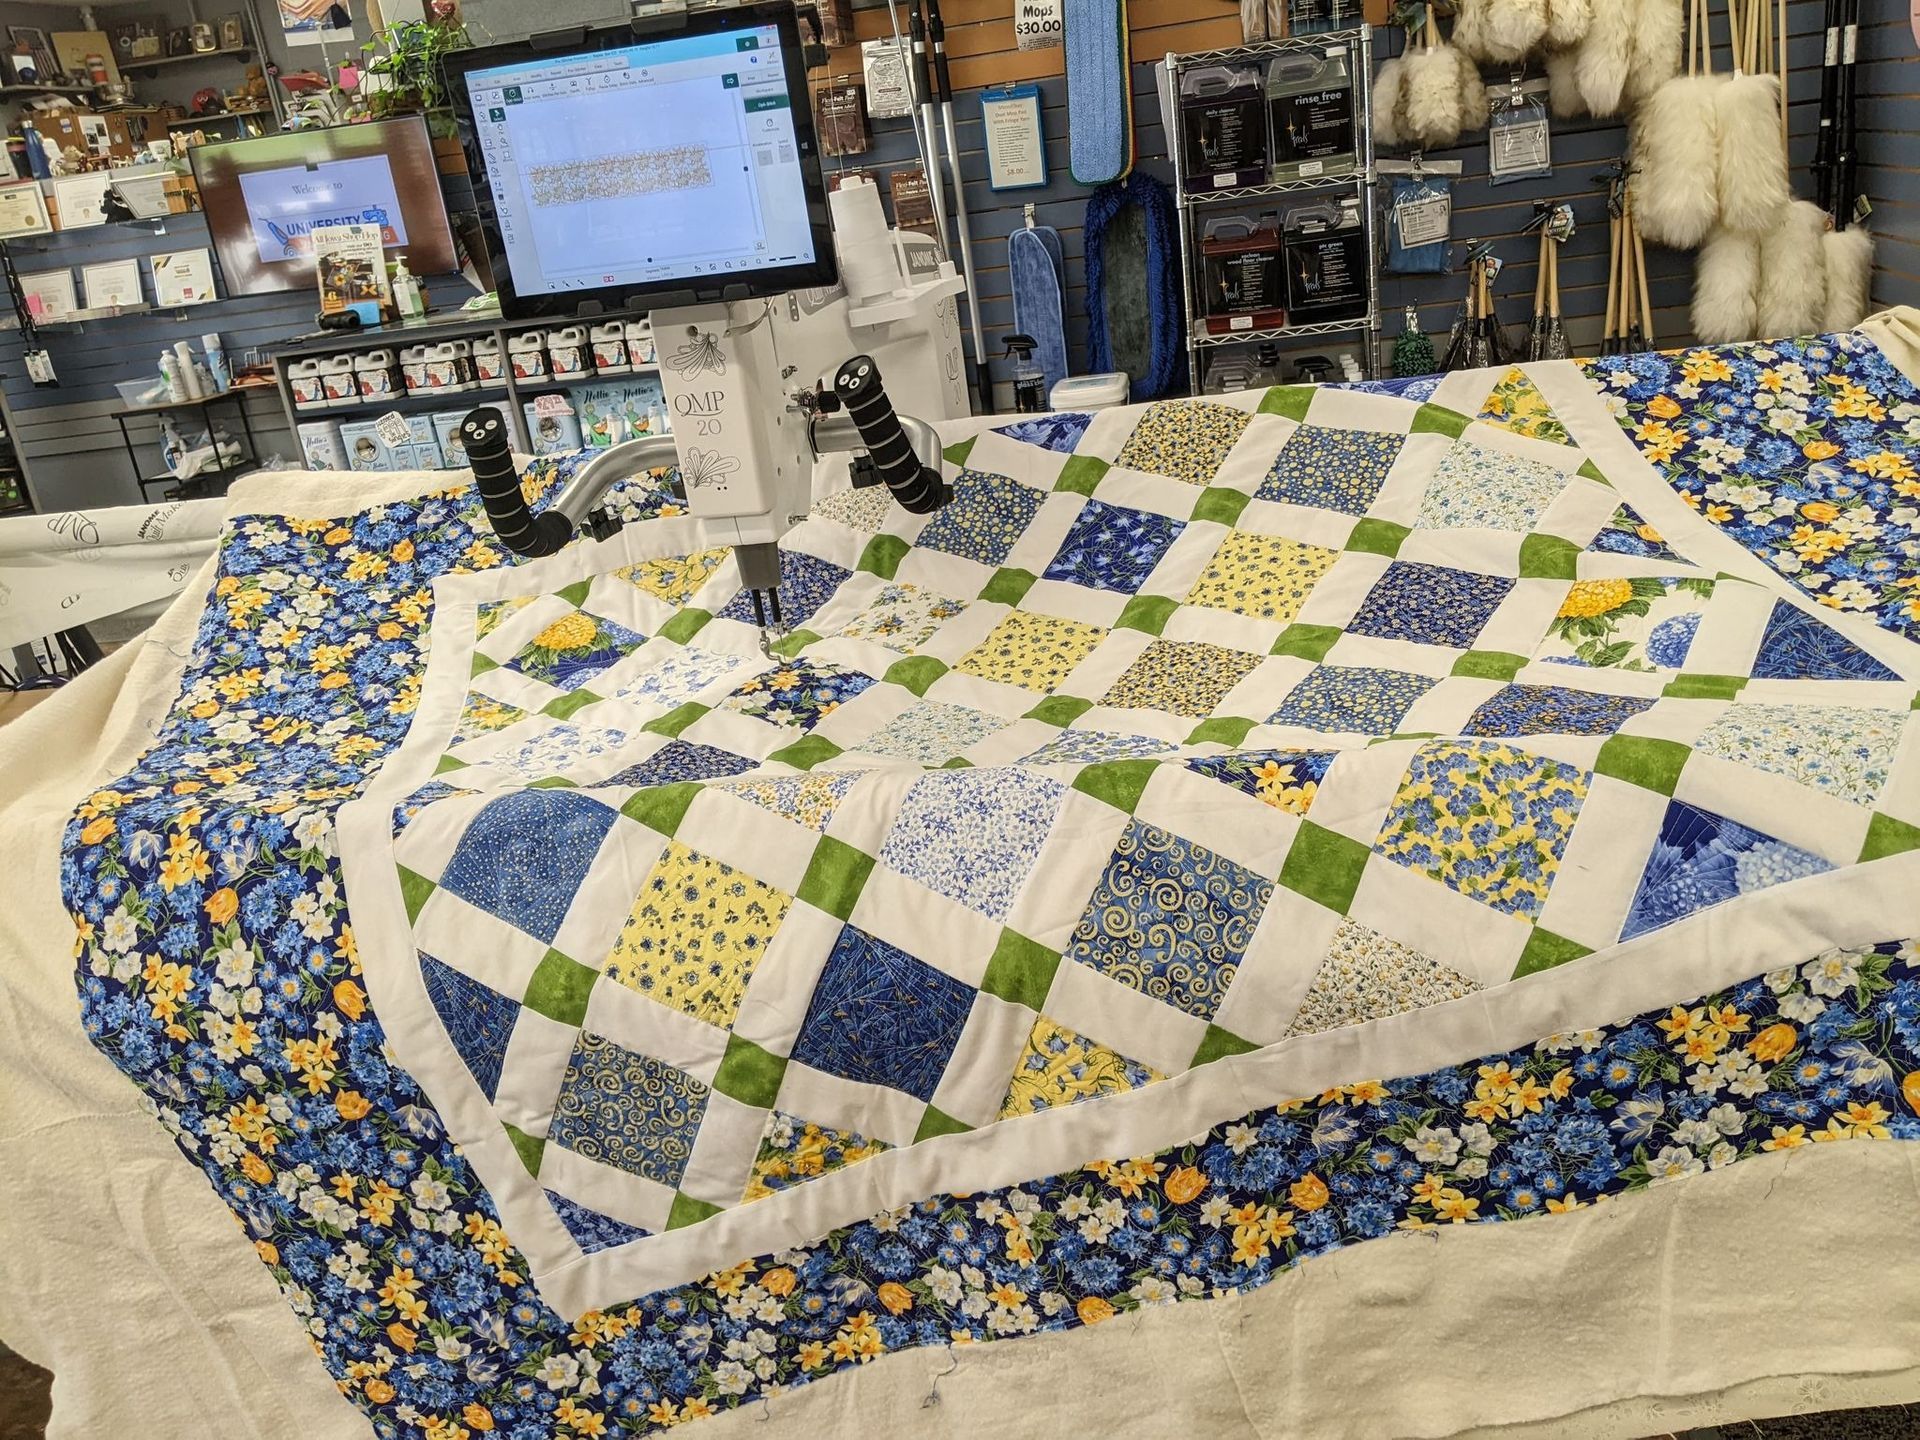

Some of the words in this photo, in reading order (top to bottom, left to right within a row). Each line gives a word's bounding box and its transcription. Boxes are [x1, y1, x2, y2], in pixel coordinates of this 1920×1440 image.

[1023, 5, 1053, 21] Mops
[1016, 20, 1061, 35] $30.00
[1295, 95, 1320, 106] rinse
[1322, 91, 1342, 101] free
[333, 182, 343, 191] to
[286, 214, 361, 236] UNIVERSITY
[623, 386, 654, 403] Nellie's
[674, 390, 725, 418] QMP
[696, 418, 722, 436] 20
[137, 509, 161, 540] JANOME
